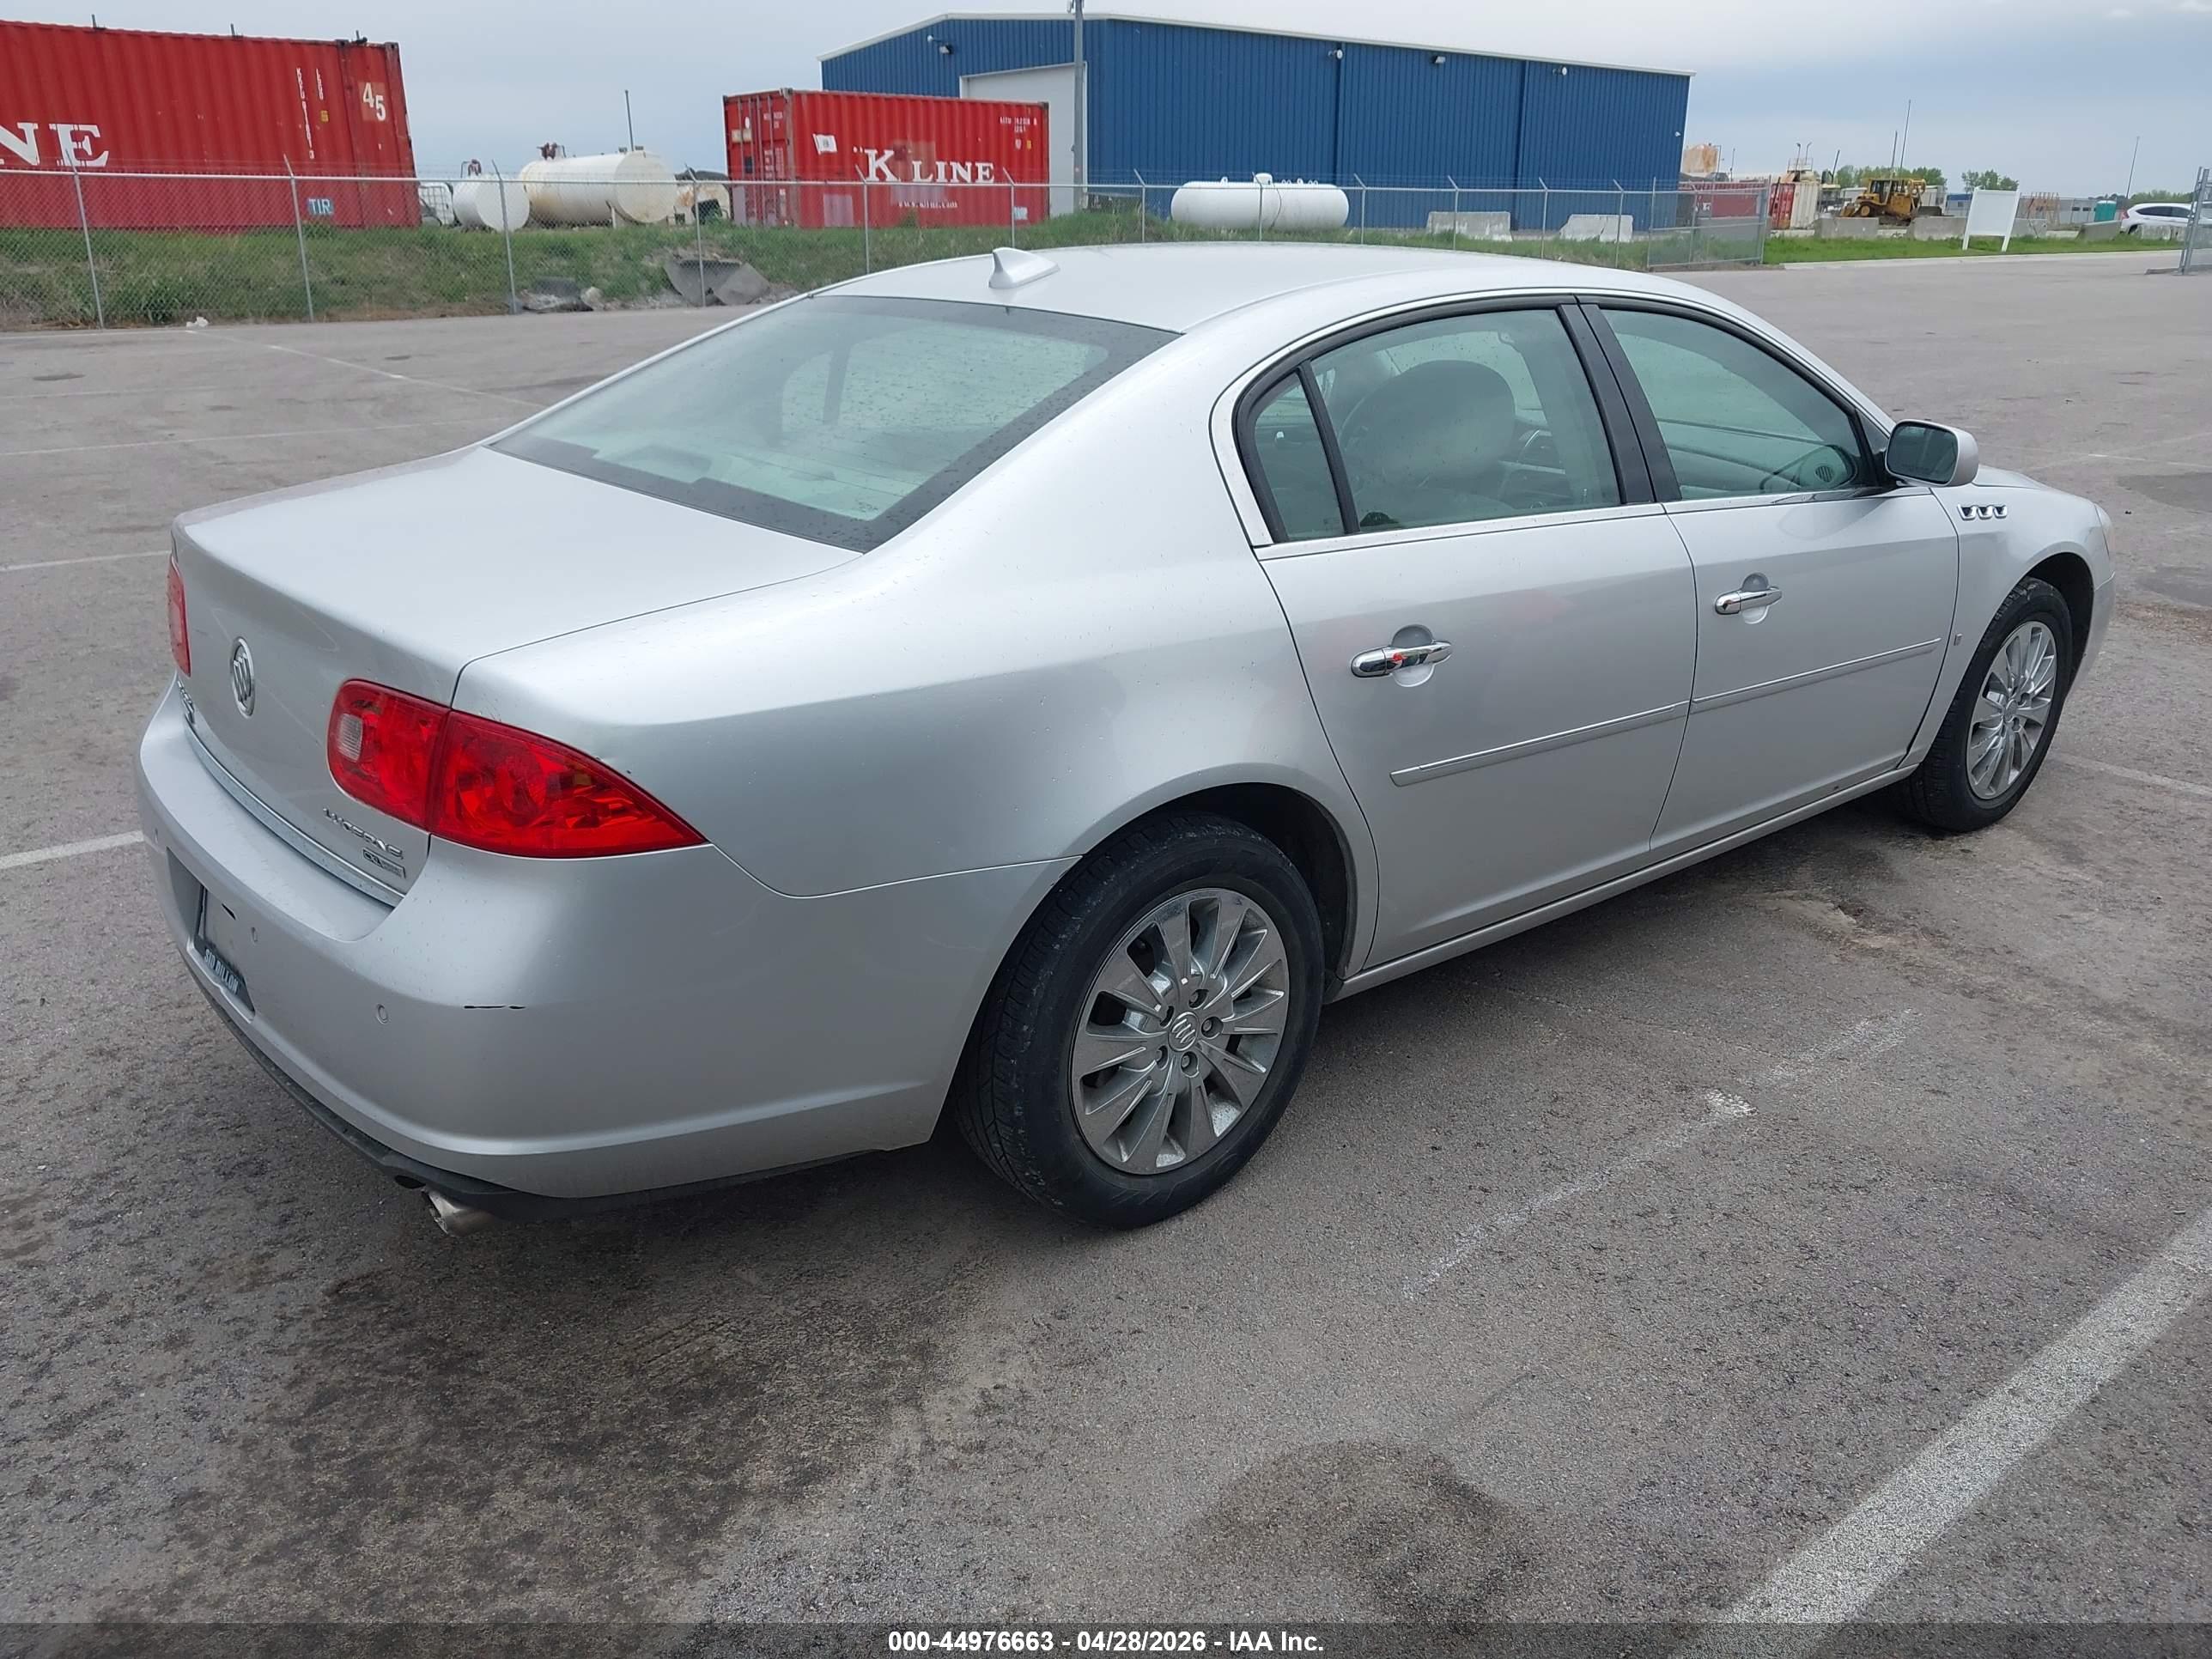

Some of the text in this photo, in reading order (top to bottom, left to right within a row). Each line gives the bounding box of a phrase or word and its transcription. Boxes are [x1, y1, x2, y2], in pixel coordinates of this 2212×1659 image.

[362, 82, 386, 122] 45
[911, 160, 995, 184] LINE
[308, 198, 332, 215] TIR
[204, 948, 239, 994] SID DILLON
